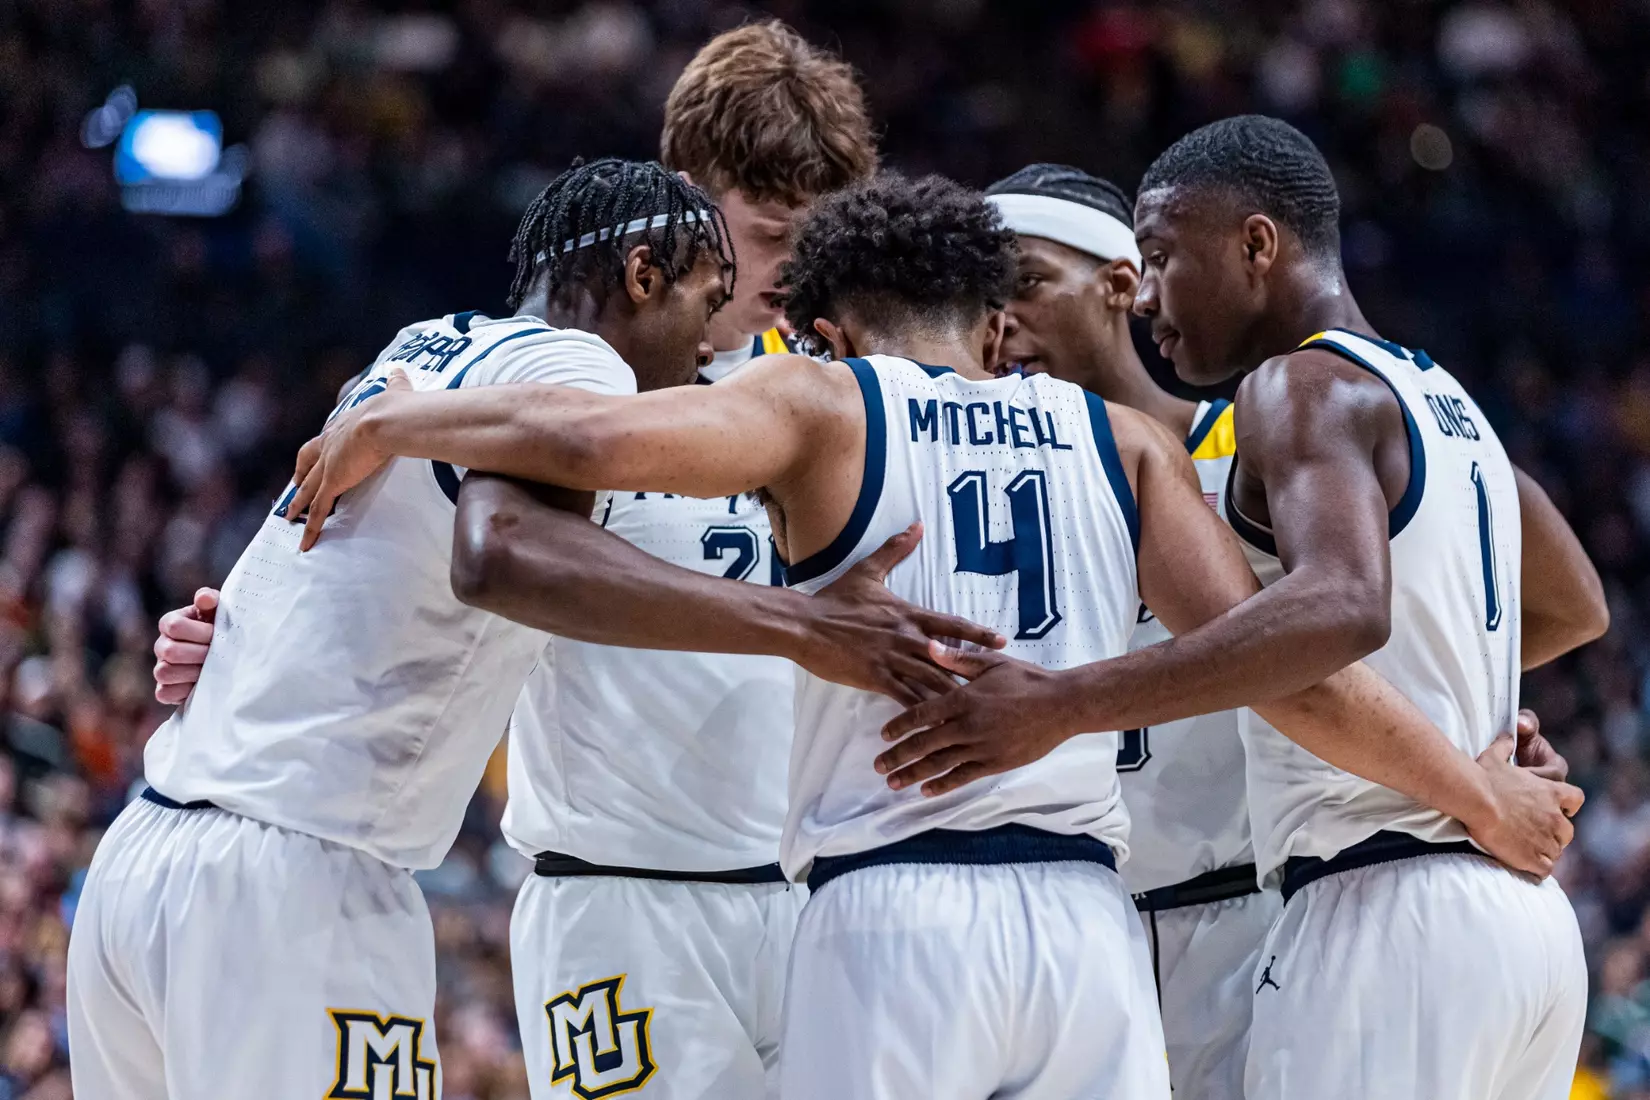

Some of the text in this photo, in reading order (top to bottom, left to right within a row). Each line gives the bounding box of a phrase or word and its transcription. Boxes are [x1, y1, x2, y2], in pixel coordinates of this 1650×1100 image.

[908, 398, 1073, 450] MTCHELL
[947, 469, 1063, 640] 4
[1470, 460, 1501, 631] 1
[544, 973, 659, 1100] MU
